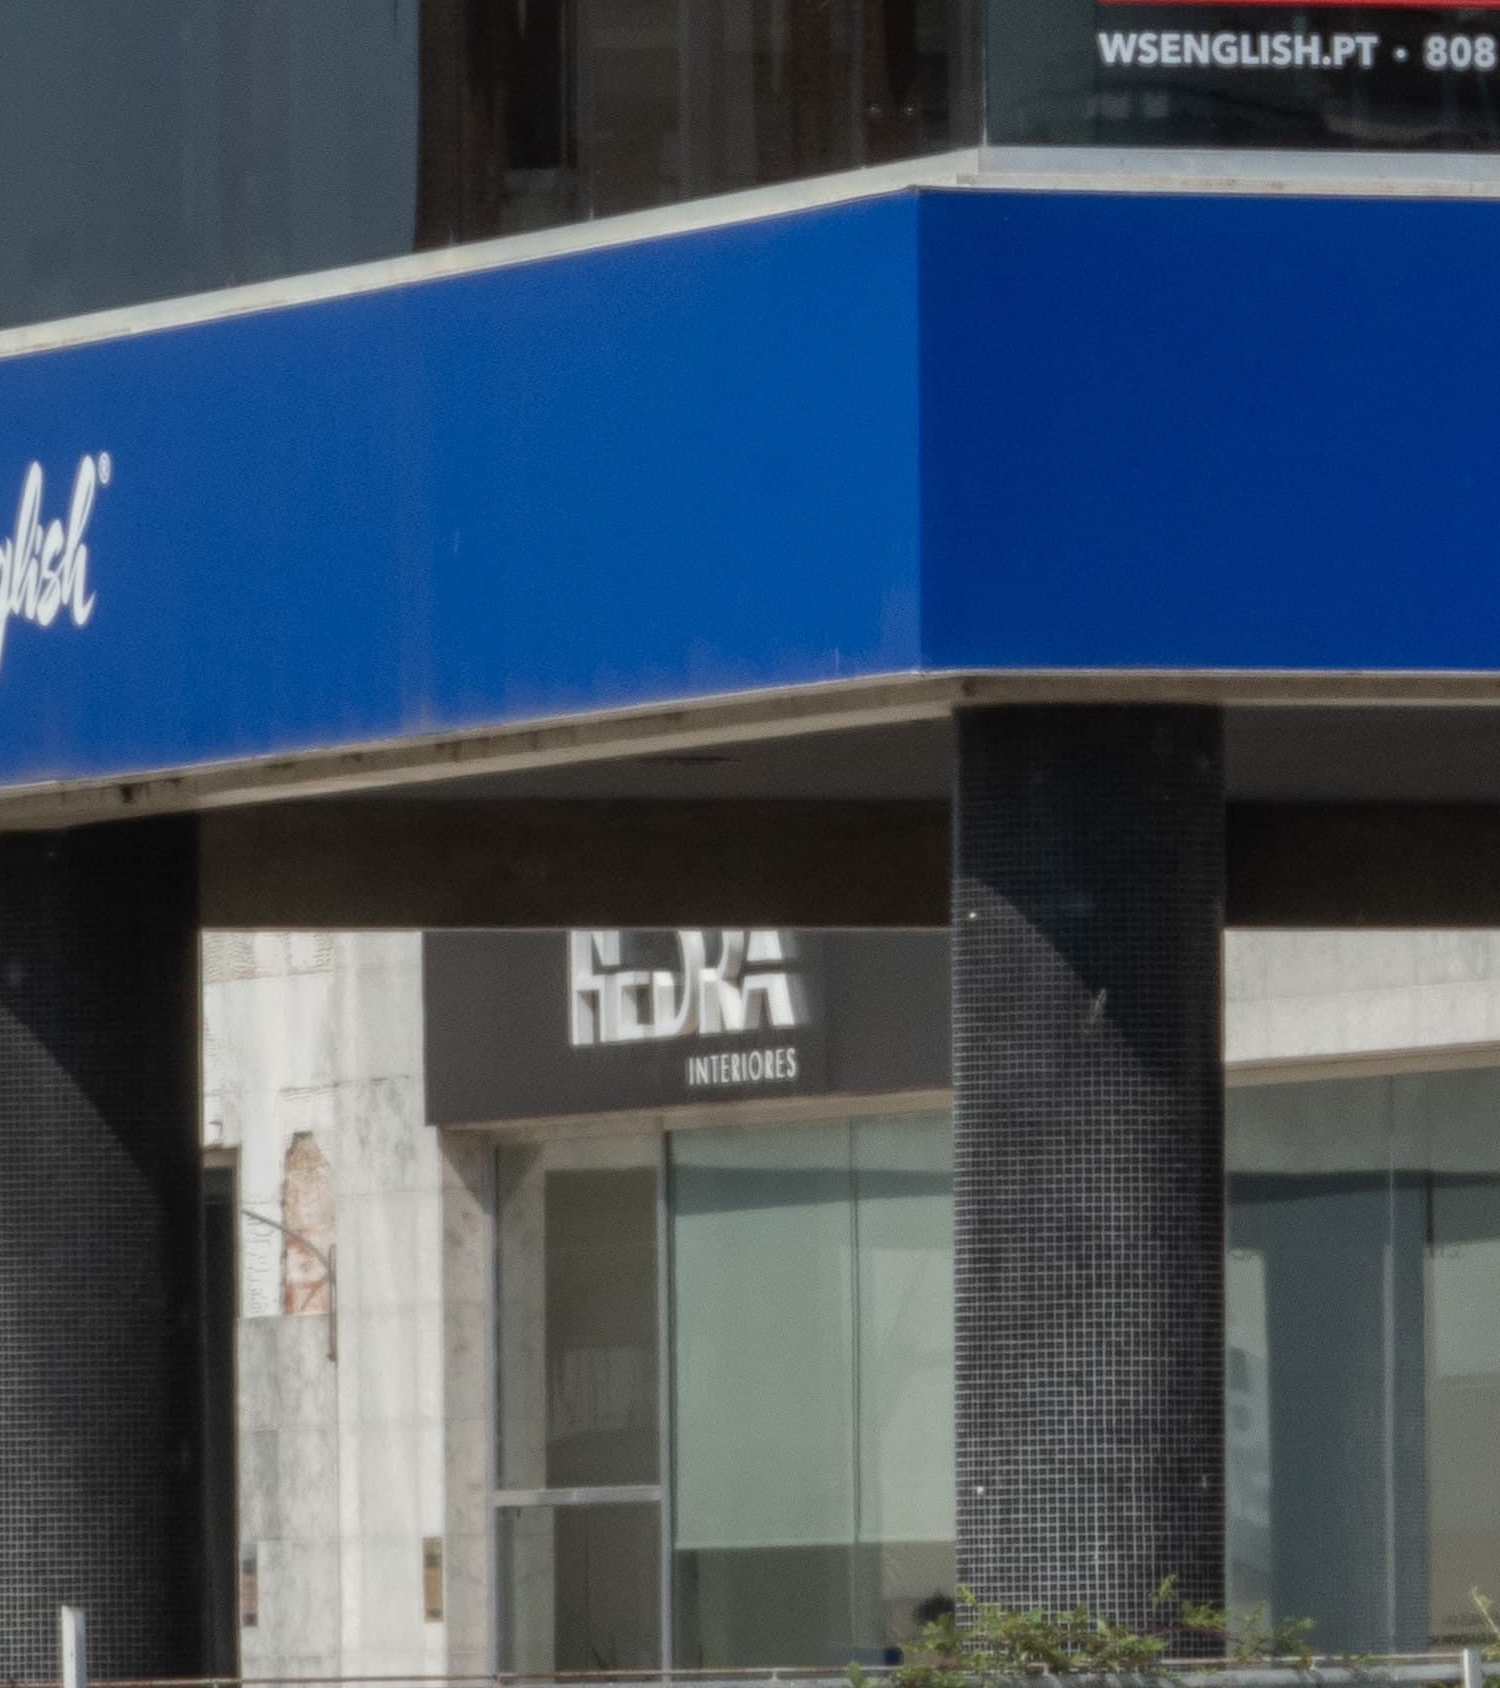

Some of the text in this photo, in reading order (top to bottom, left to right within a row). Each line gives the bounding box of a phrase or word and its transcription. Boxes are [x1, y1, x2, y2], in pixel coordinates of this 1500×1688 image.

[1099, 33, 1379, 66] WSENGLISH.PT
[1425, 35, 1497, 69] 808
[687, 1048, 797, 1086] INTERIORES
